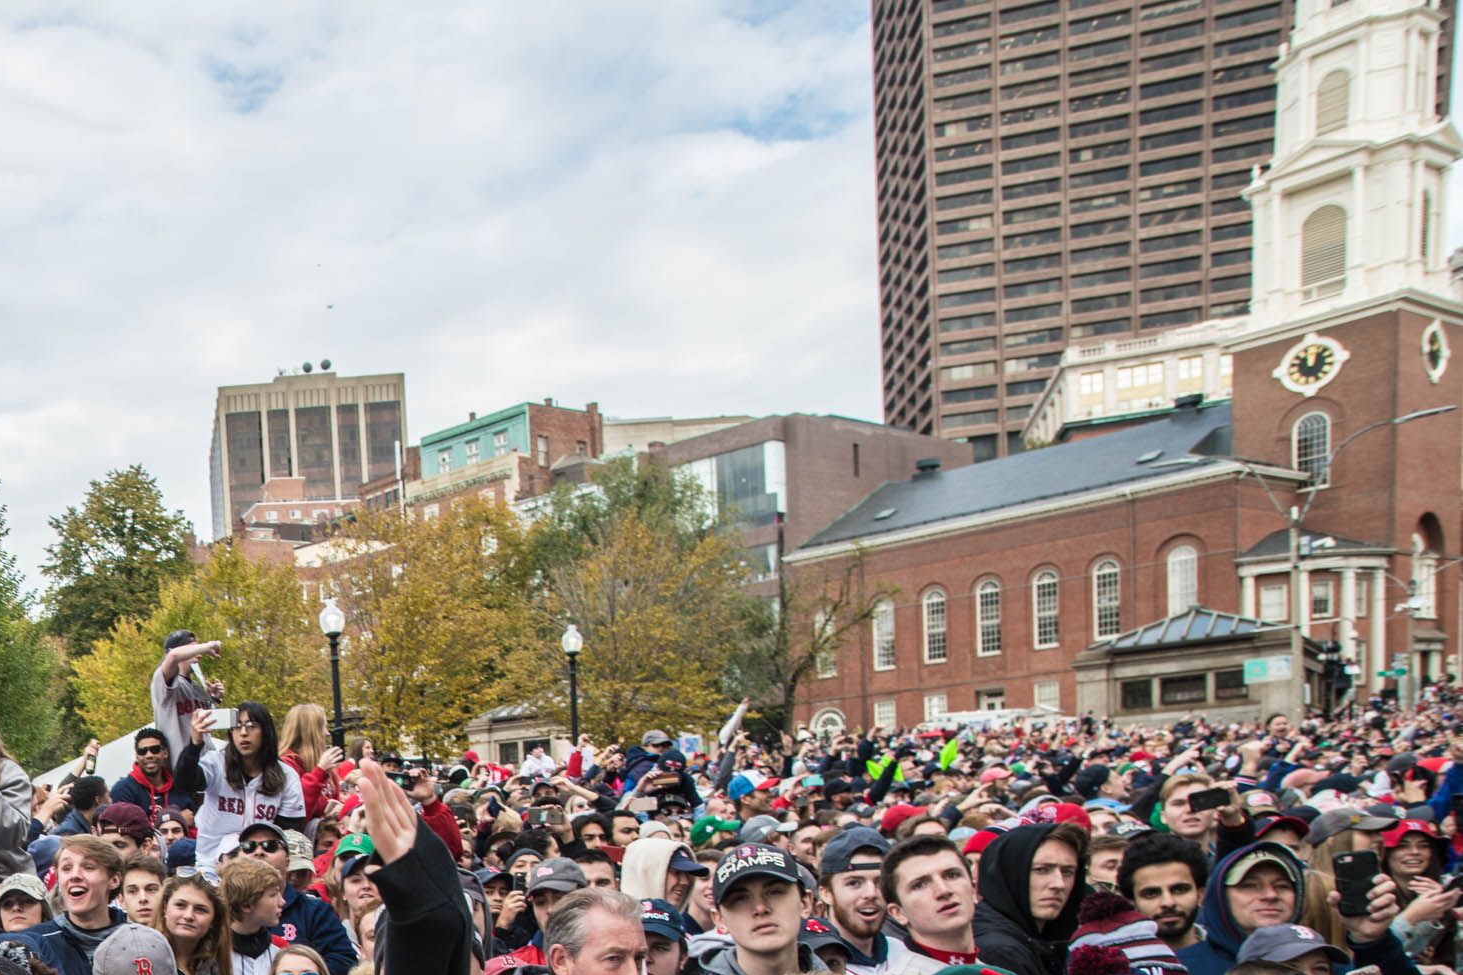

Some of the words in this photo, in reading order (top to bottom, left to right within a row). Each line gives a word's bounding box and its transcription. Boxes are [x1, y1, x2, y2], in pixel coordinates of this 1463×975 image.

[218, 796, 244, 816] RED
[255, 803, 276, 821] SO
[282, 923, 297, 941] B
